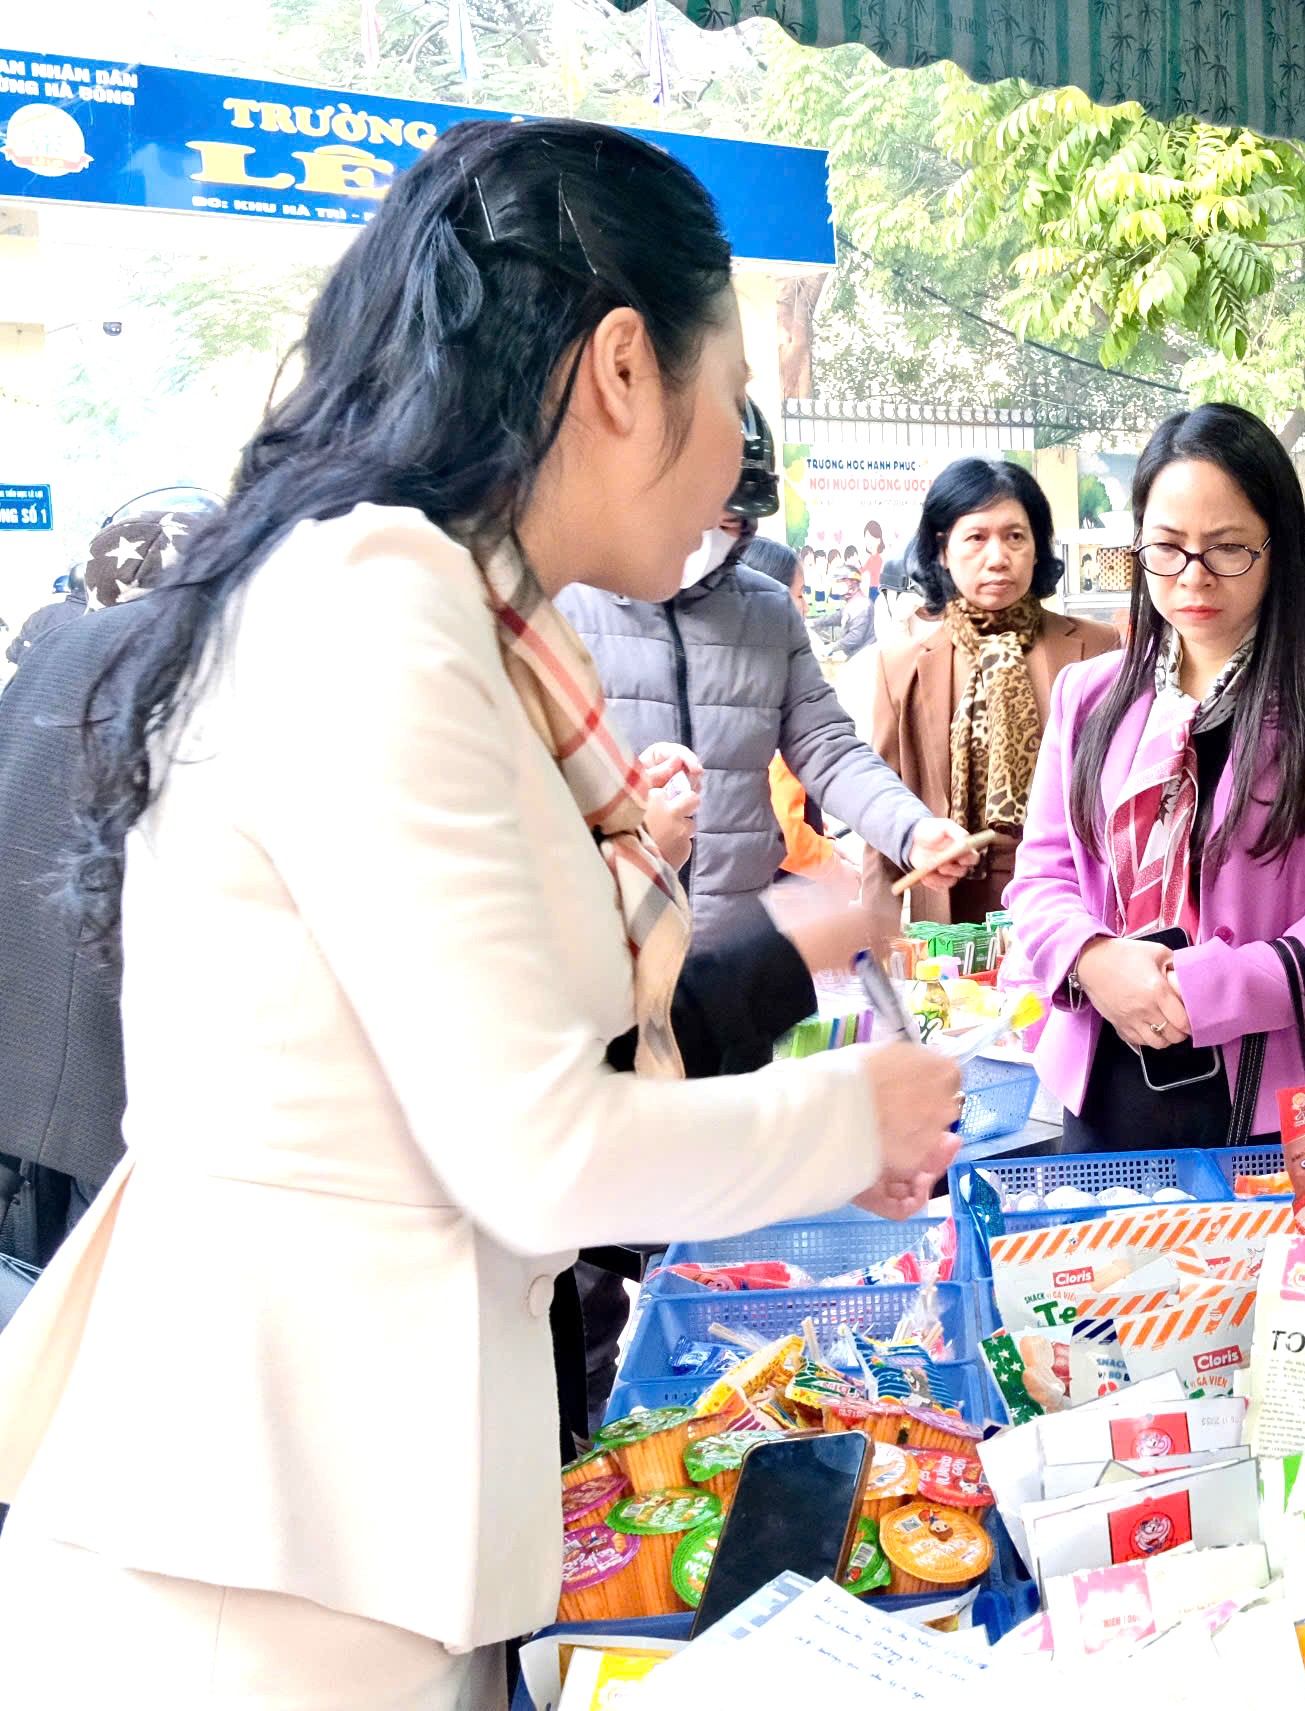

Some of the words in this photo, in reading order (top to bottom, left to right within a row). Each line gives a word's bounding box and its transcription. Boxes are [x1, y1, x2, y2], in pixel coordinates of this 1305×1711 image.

[31, 62, 90, 83] NHÂN
[95, 68, 138, 89] DÂN
[45, 79, 73, 99] HÀ
[223, 97, 438, 151] TRƯỜNG
[185, 140, 395, 200] LÊ
[234, 199, 277, 214] KHU
[282, 203, 310, 218] HÀ
[0, 508, 18, 524] NG
[21, 503, 38, 524] SỐ
[40, 508, 47, 524] 1
[1055, 1269, 1092, 1286] Cloris
[1197, 1350, 1239, 1370] Cloris
